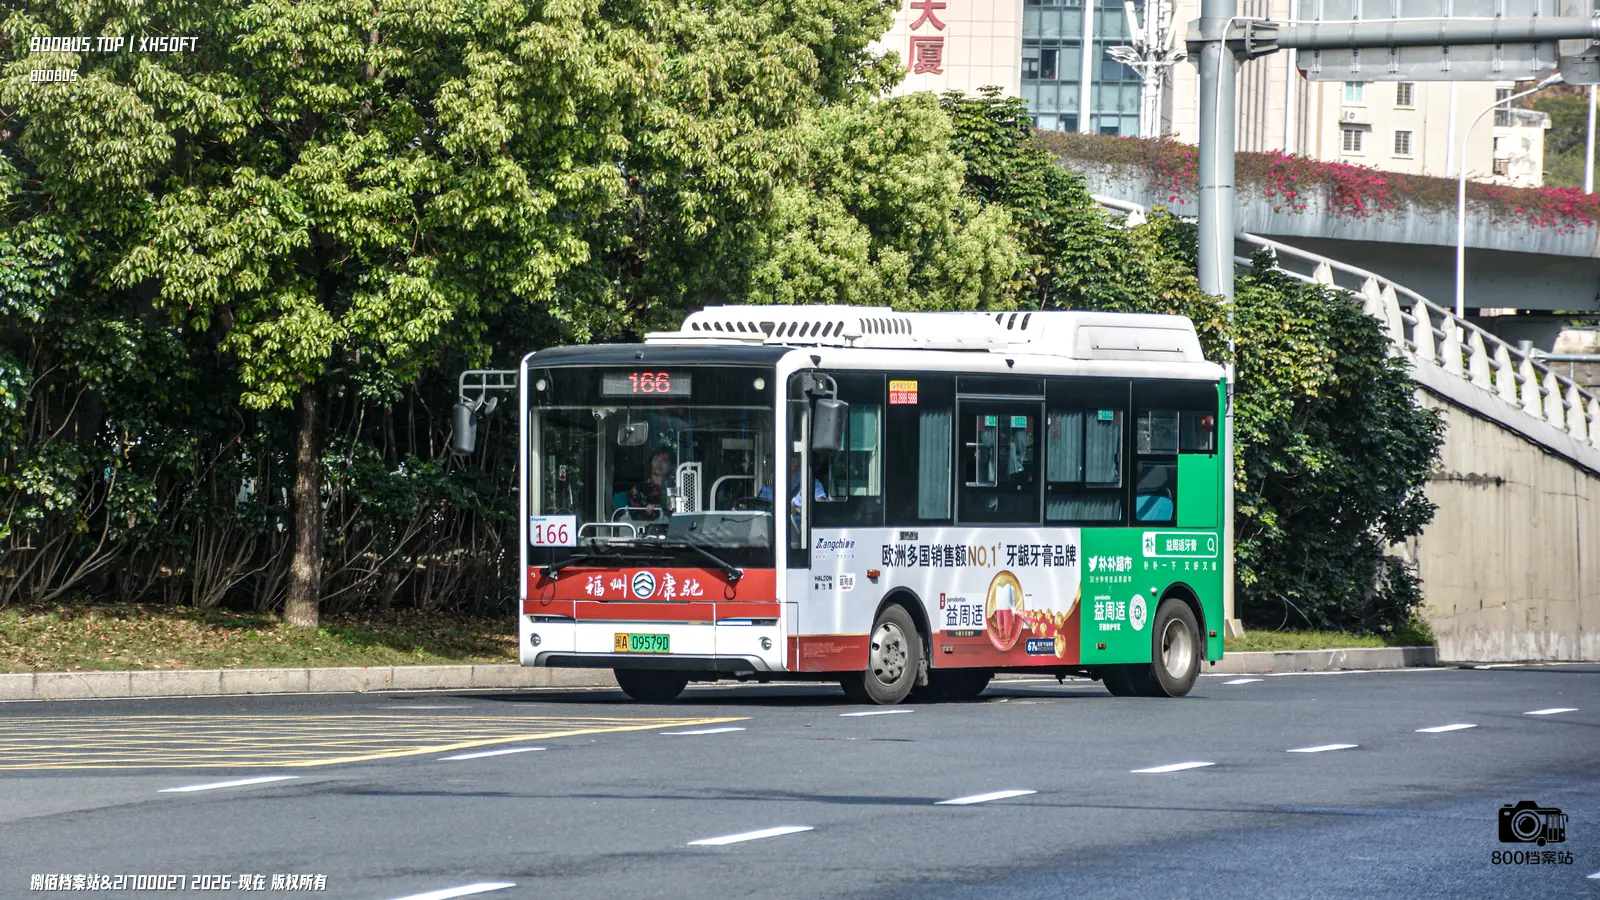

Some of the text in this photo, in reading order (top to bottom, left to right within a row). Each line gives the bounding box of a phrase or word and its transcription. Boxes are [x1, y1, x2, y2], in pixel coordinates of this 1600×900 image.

[908, 0, 947, 75] 大厦
[628, 372, 671, 393] 166
[535, 524, 569, 544] 166
[1166, 538, 1197, 552] 益周适牙膏
[1006, 543, 1076, 568] 牙龈牙膏品牌
[1098, 556, 1132, 572] 朴朴超市
[585, 575, 628, 599] 福州
[946, 604, 983, 627] 益周适
[1094, 601, 1126, 621] 益周适
[632, 637, 669, 650] 09579D
